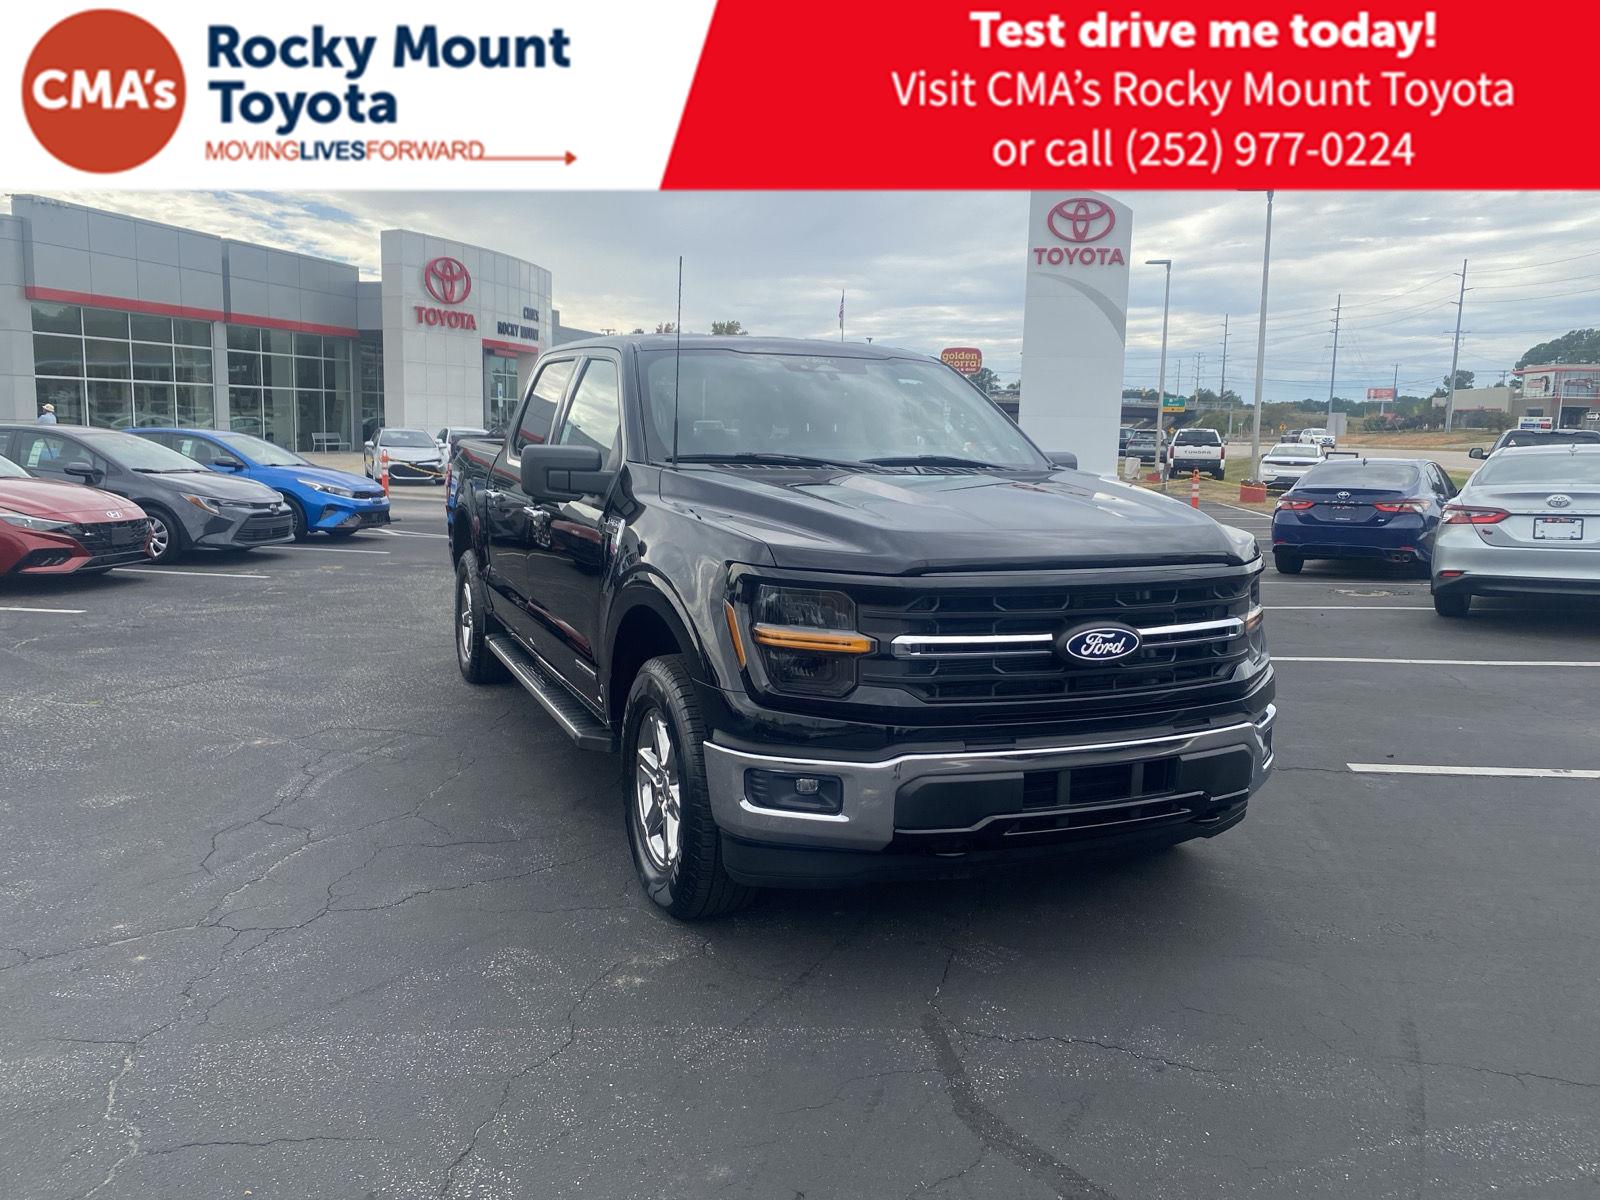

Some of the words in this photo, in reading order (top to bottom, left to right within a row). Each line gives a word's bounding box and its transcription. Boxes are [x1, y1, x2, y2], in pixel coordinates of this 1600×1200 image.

[1033, 247, 1125, 266] TOYOTA
[414, 305, 477, 330] TOYOTA
[497, 320, 519, 337] ROCKY
[942, 351, 977, 362] golden
[1081, 632, 1126, 656] Ford
